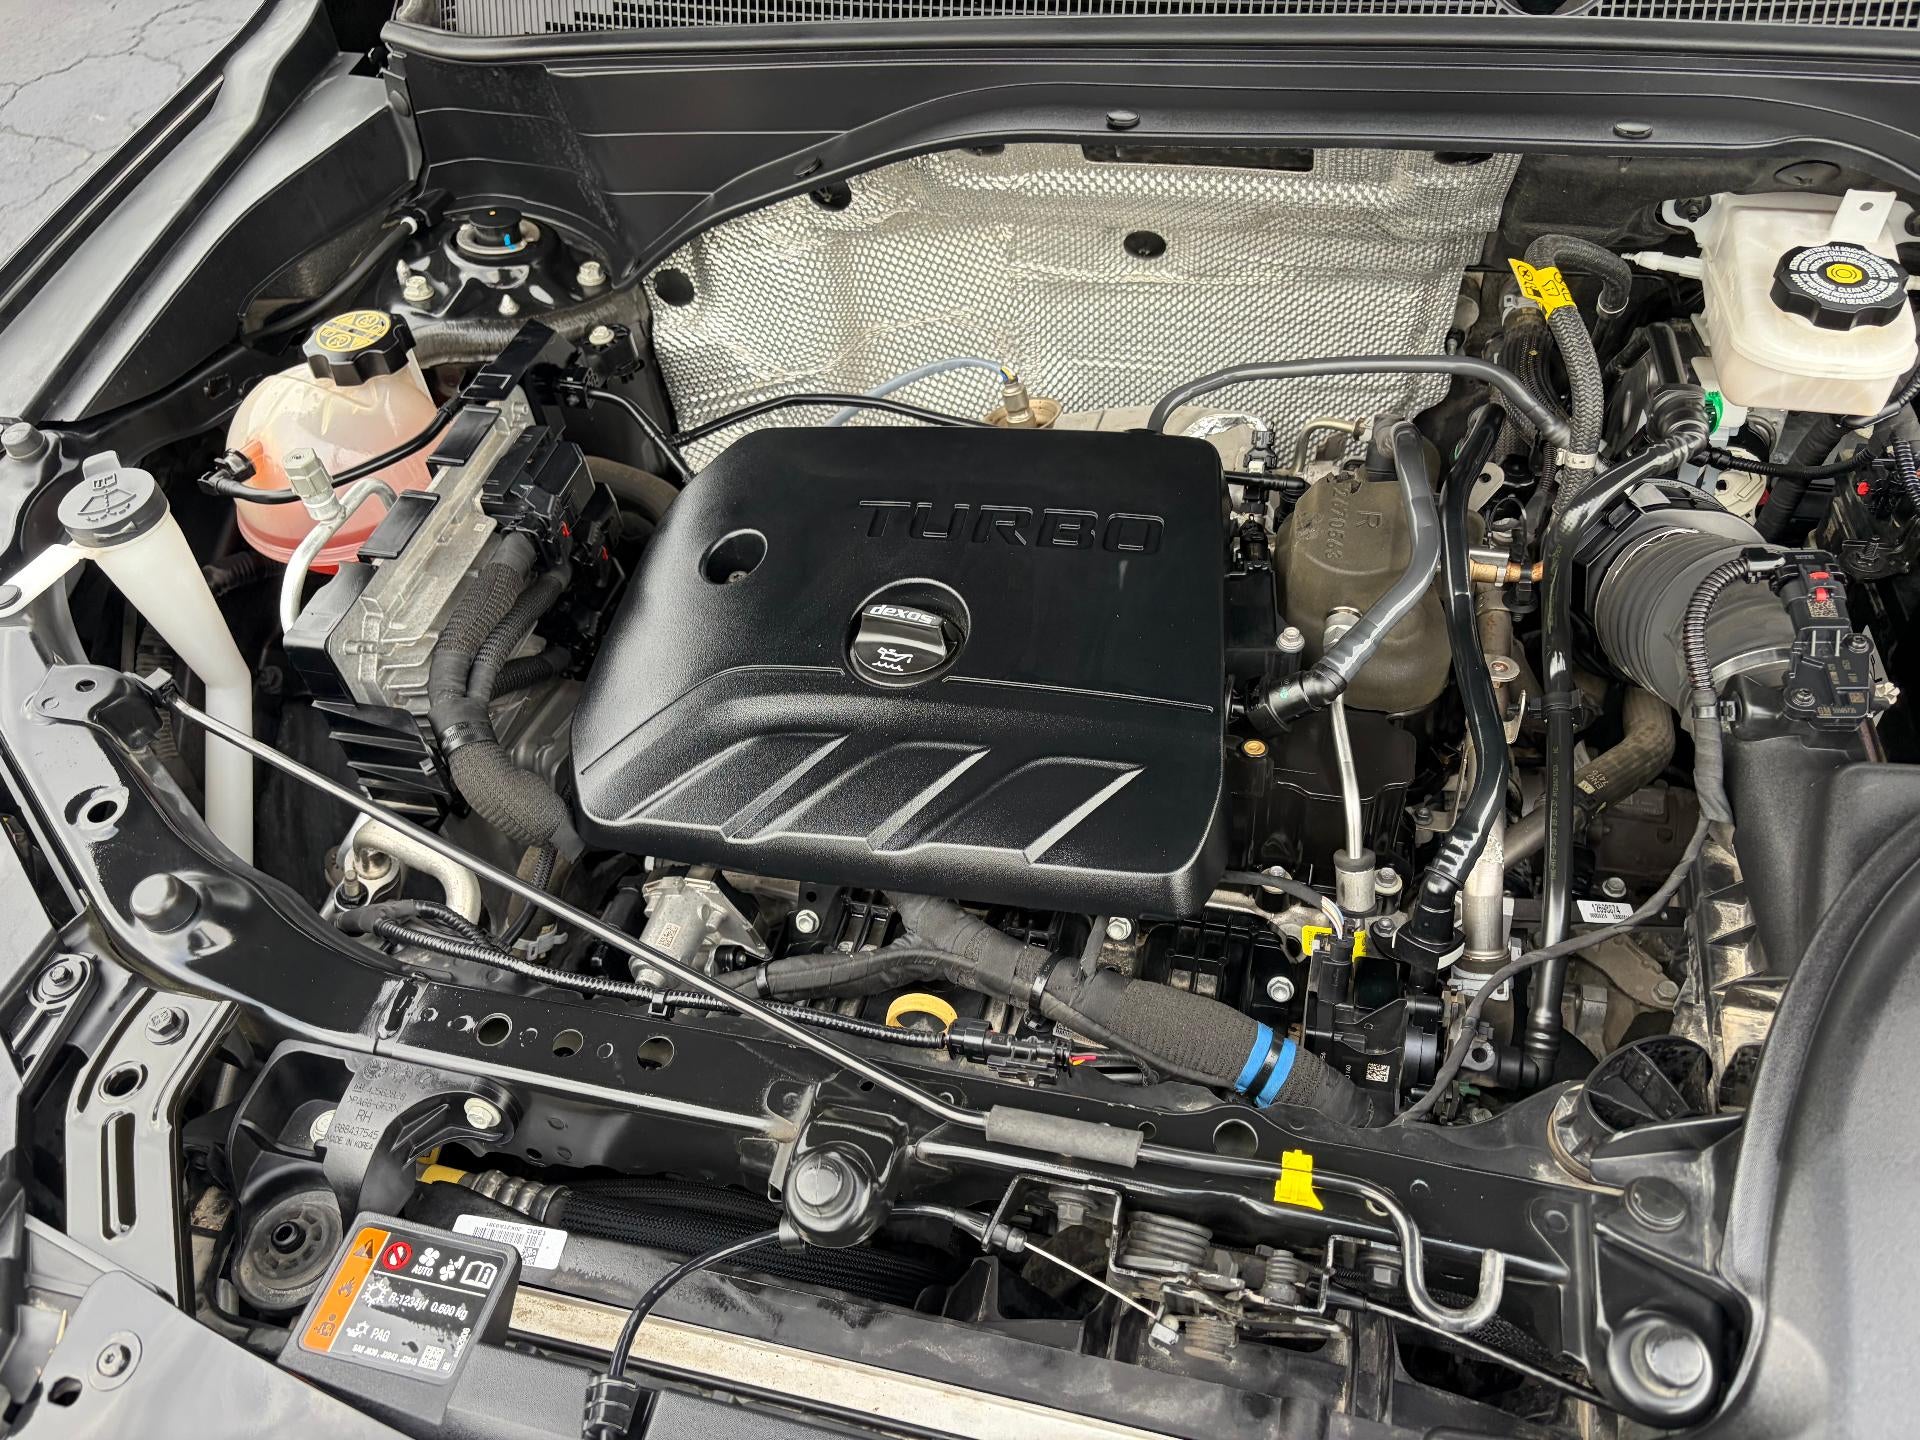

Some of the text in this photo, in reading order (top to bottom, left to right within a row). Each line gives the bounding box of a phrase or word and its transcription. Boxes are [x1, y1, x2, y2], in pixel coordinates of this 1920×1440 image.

[1818, 292, 1840, 303] FROM
[1845, 297, 1875, 305] SEALED
[858, 500, 1165, 554] TURBO
[869, 604, 934, 625] dexos
[355, 1109, 373, 1123] RH
[354, 1140, 374, 1150] KOREA
[410, 1264, 434, 1277] AUTO
[430, 1301, 456, 1317] 0.600
[455, 1305, 469, 1321] kg
[370, 1327, 391, 1343] PAG
